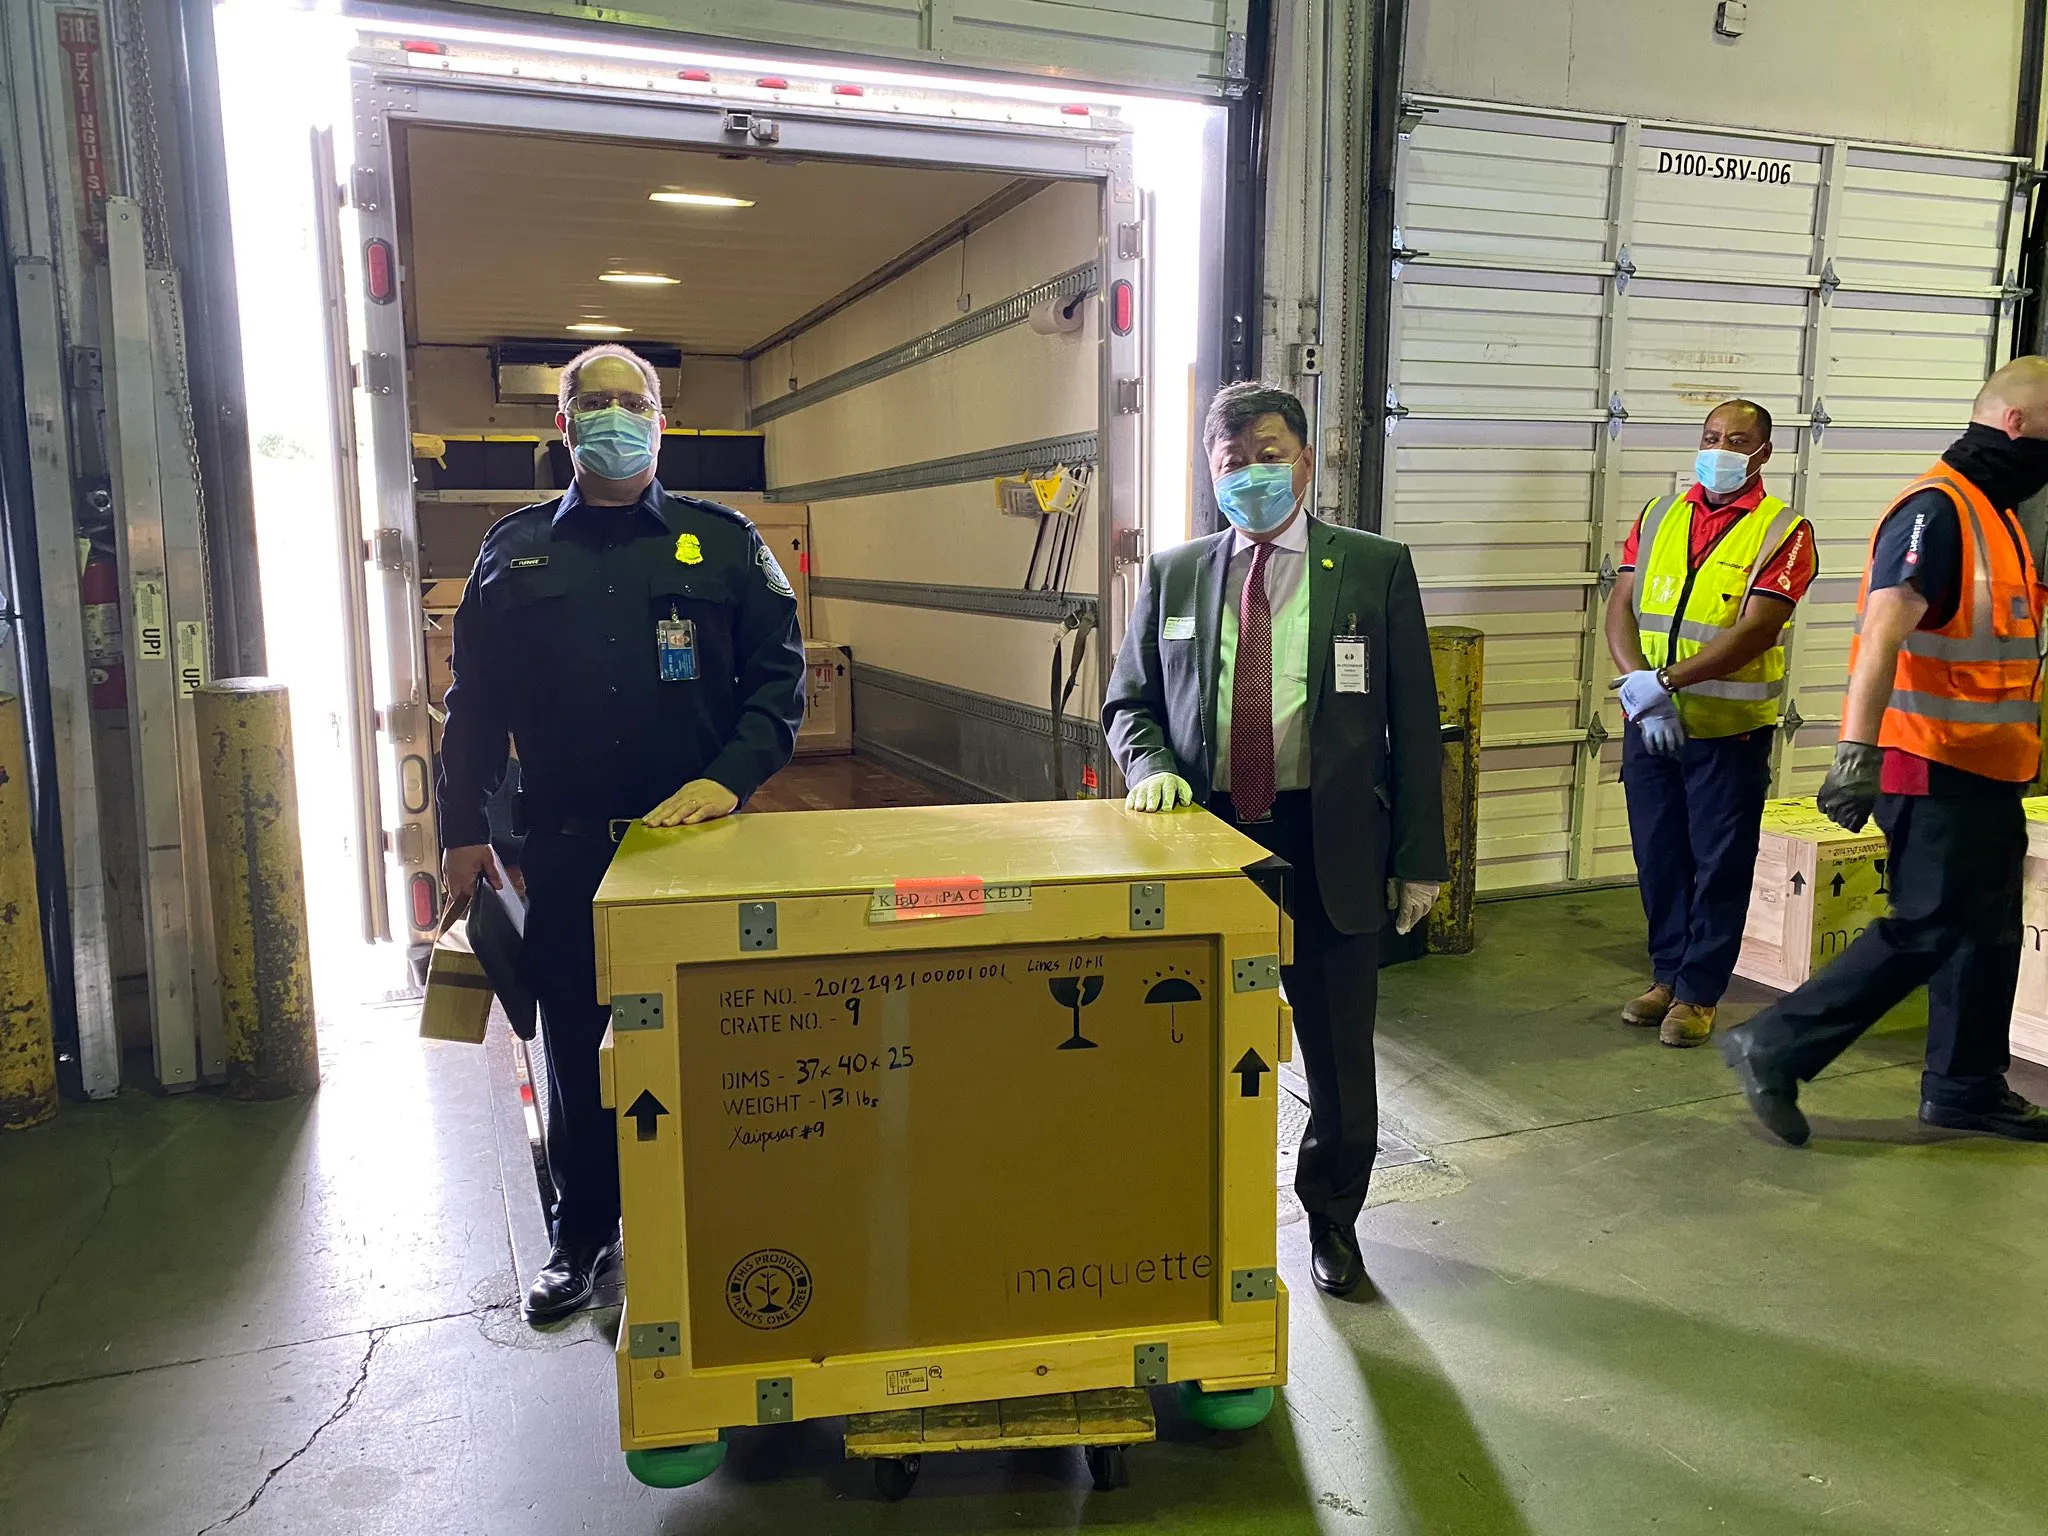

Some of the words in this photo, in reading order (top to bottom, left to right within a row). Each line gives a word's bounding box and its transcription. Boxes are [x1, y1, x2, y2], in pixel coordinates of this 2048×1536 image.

[59, 17, 98, 43] FIRE
[75, 52, 104, 244] EXTINGUIS
[1658, 151, 1791, 185] D100-SRV-006
[1909, 514, 1926, 552] swissport
[1784, 530, 1804, 576] swissport
[942, 886, 1023, 903] PACKED
[1027, 959, 1060, 972] Lines
[720, 990, 755, 1008] REF
[764, 987, 797, 1005] NO.
[720, 1015, 782, 1036] CRATE
[790, 1012, 823, 1031] NO.
[845, 997, 861, 1026] 9
[722, 1070, 770, 1090] DIMS
[722, 1094, 801, 1116] WEIGHT
[733, 1261, 754, 1282] THIS
[755, 1254, 804, 1277] PRODUCT
[1016, 1251, 1213, 1299] maquette
[731, 1294, 763, 1324] PLANTS
[767, 1311, 791, 1325] ONE
[789, 1288, 807, 1312] TREE
